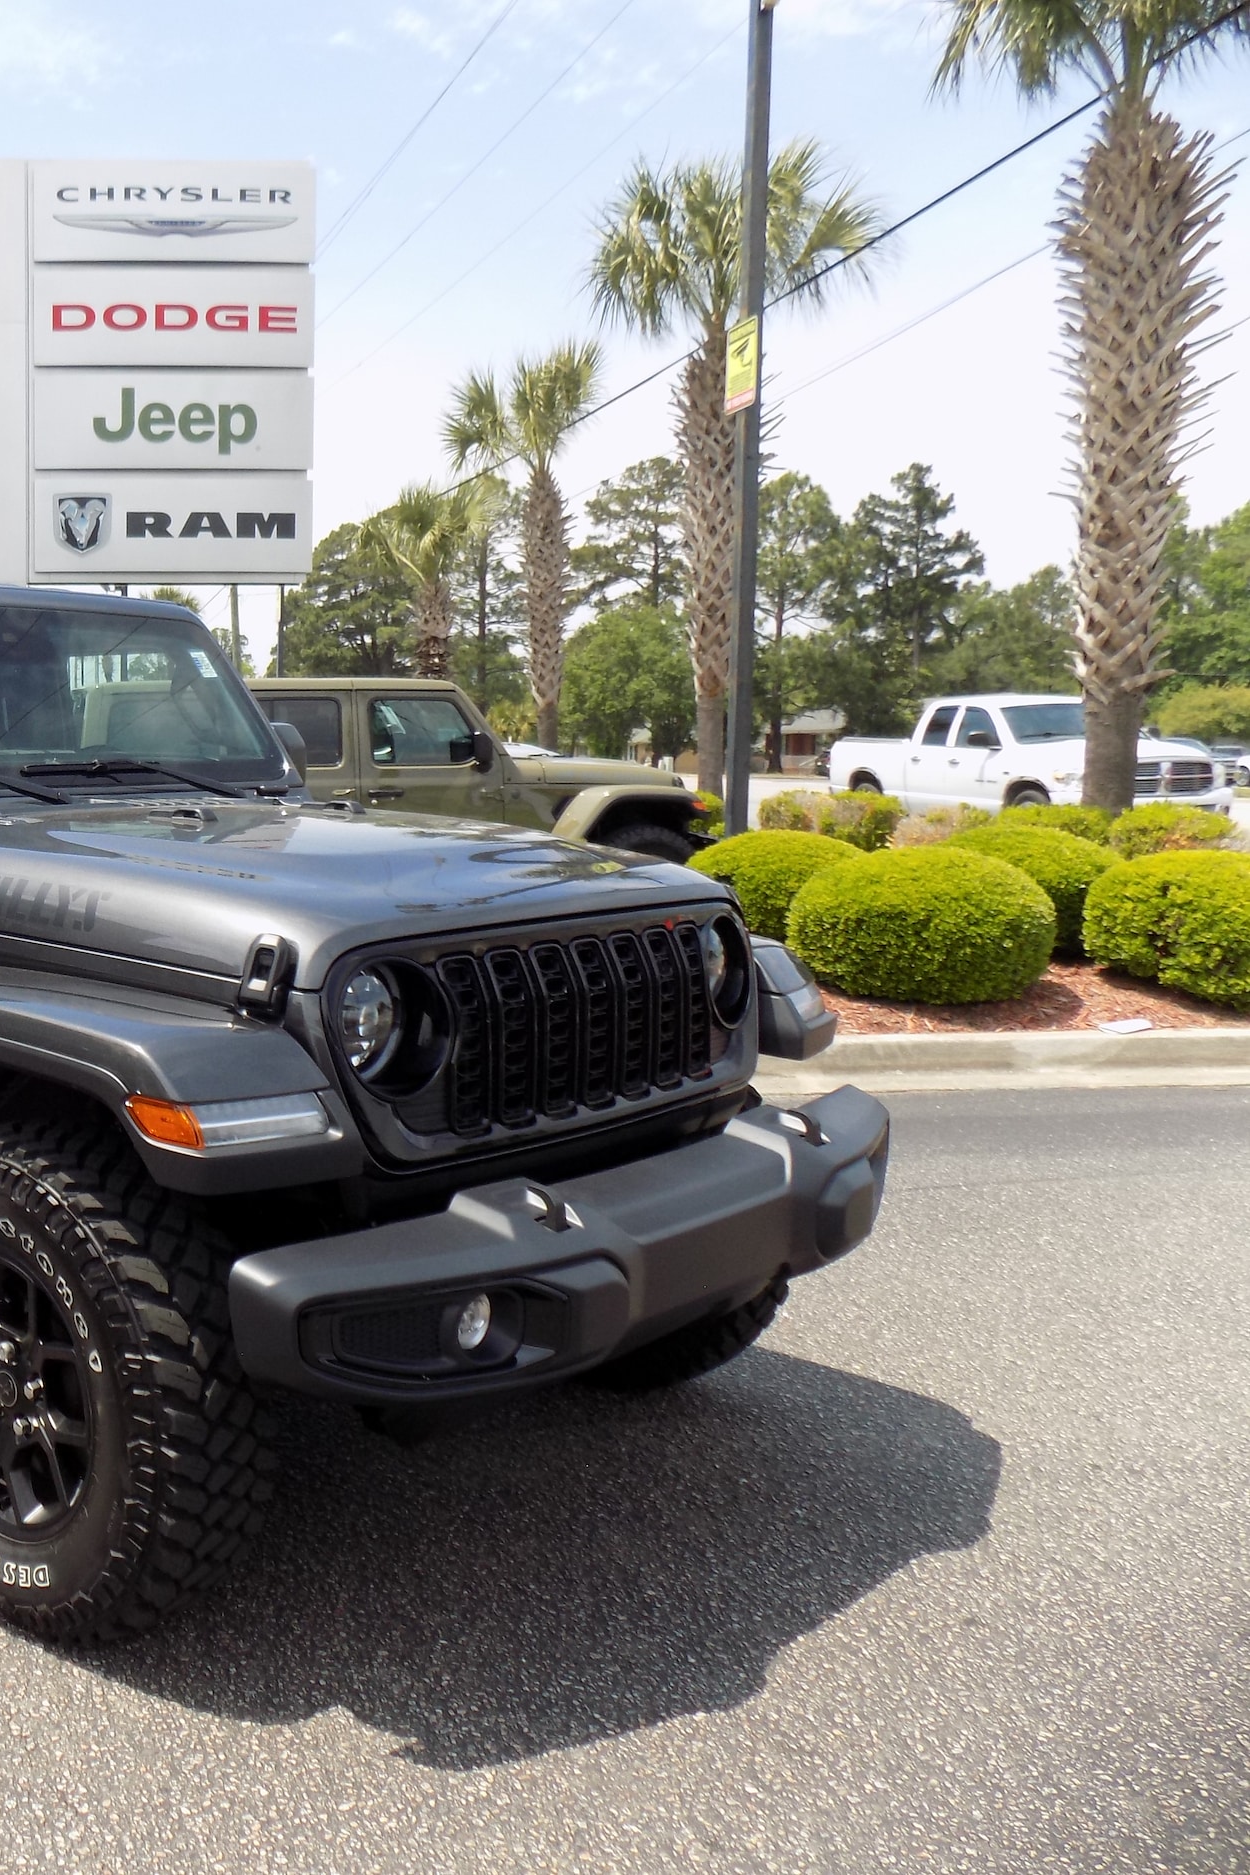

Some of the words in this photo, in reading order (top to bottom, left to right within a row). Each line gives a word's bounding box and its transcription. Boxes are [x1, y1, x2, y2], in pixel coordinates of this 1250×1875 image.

[56, 186, 293, 205] CHRYSLER
[52, 303, 298, 334] DODGE
[92, 387, 258, 455] Jeep
[125, 511, 296, 539] RAM
